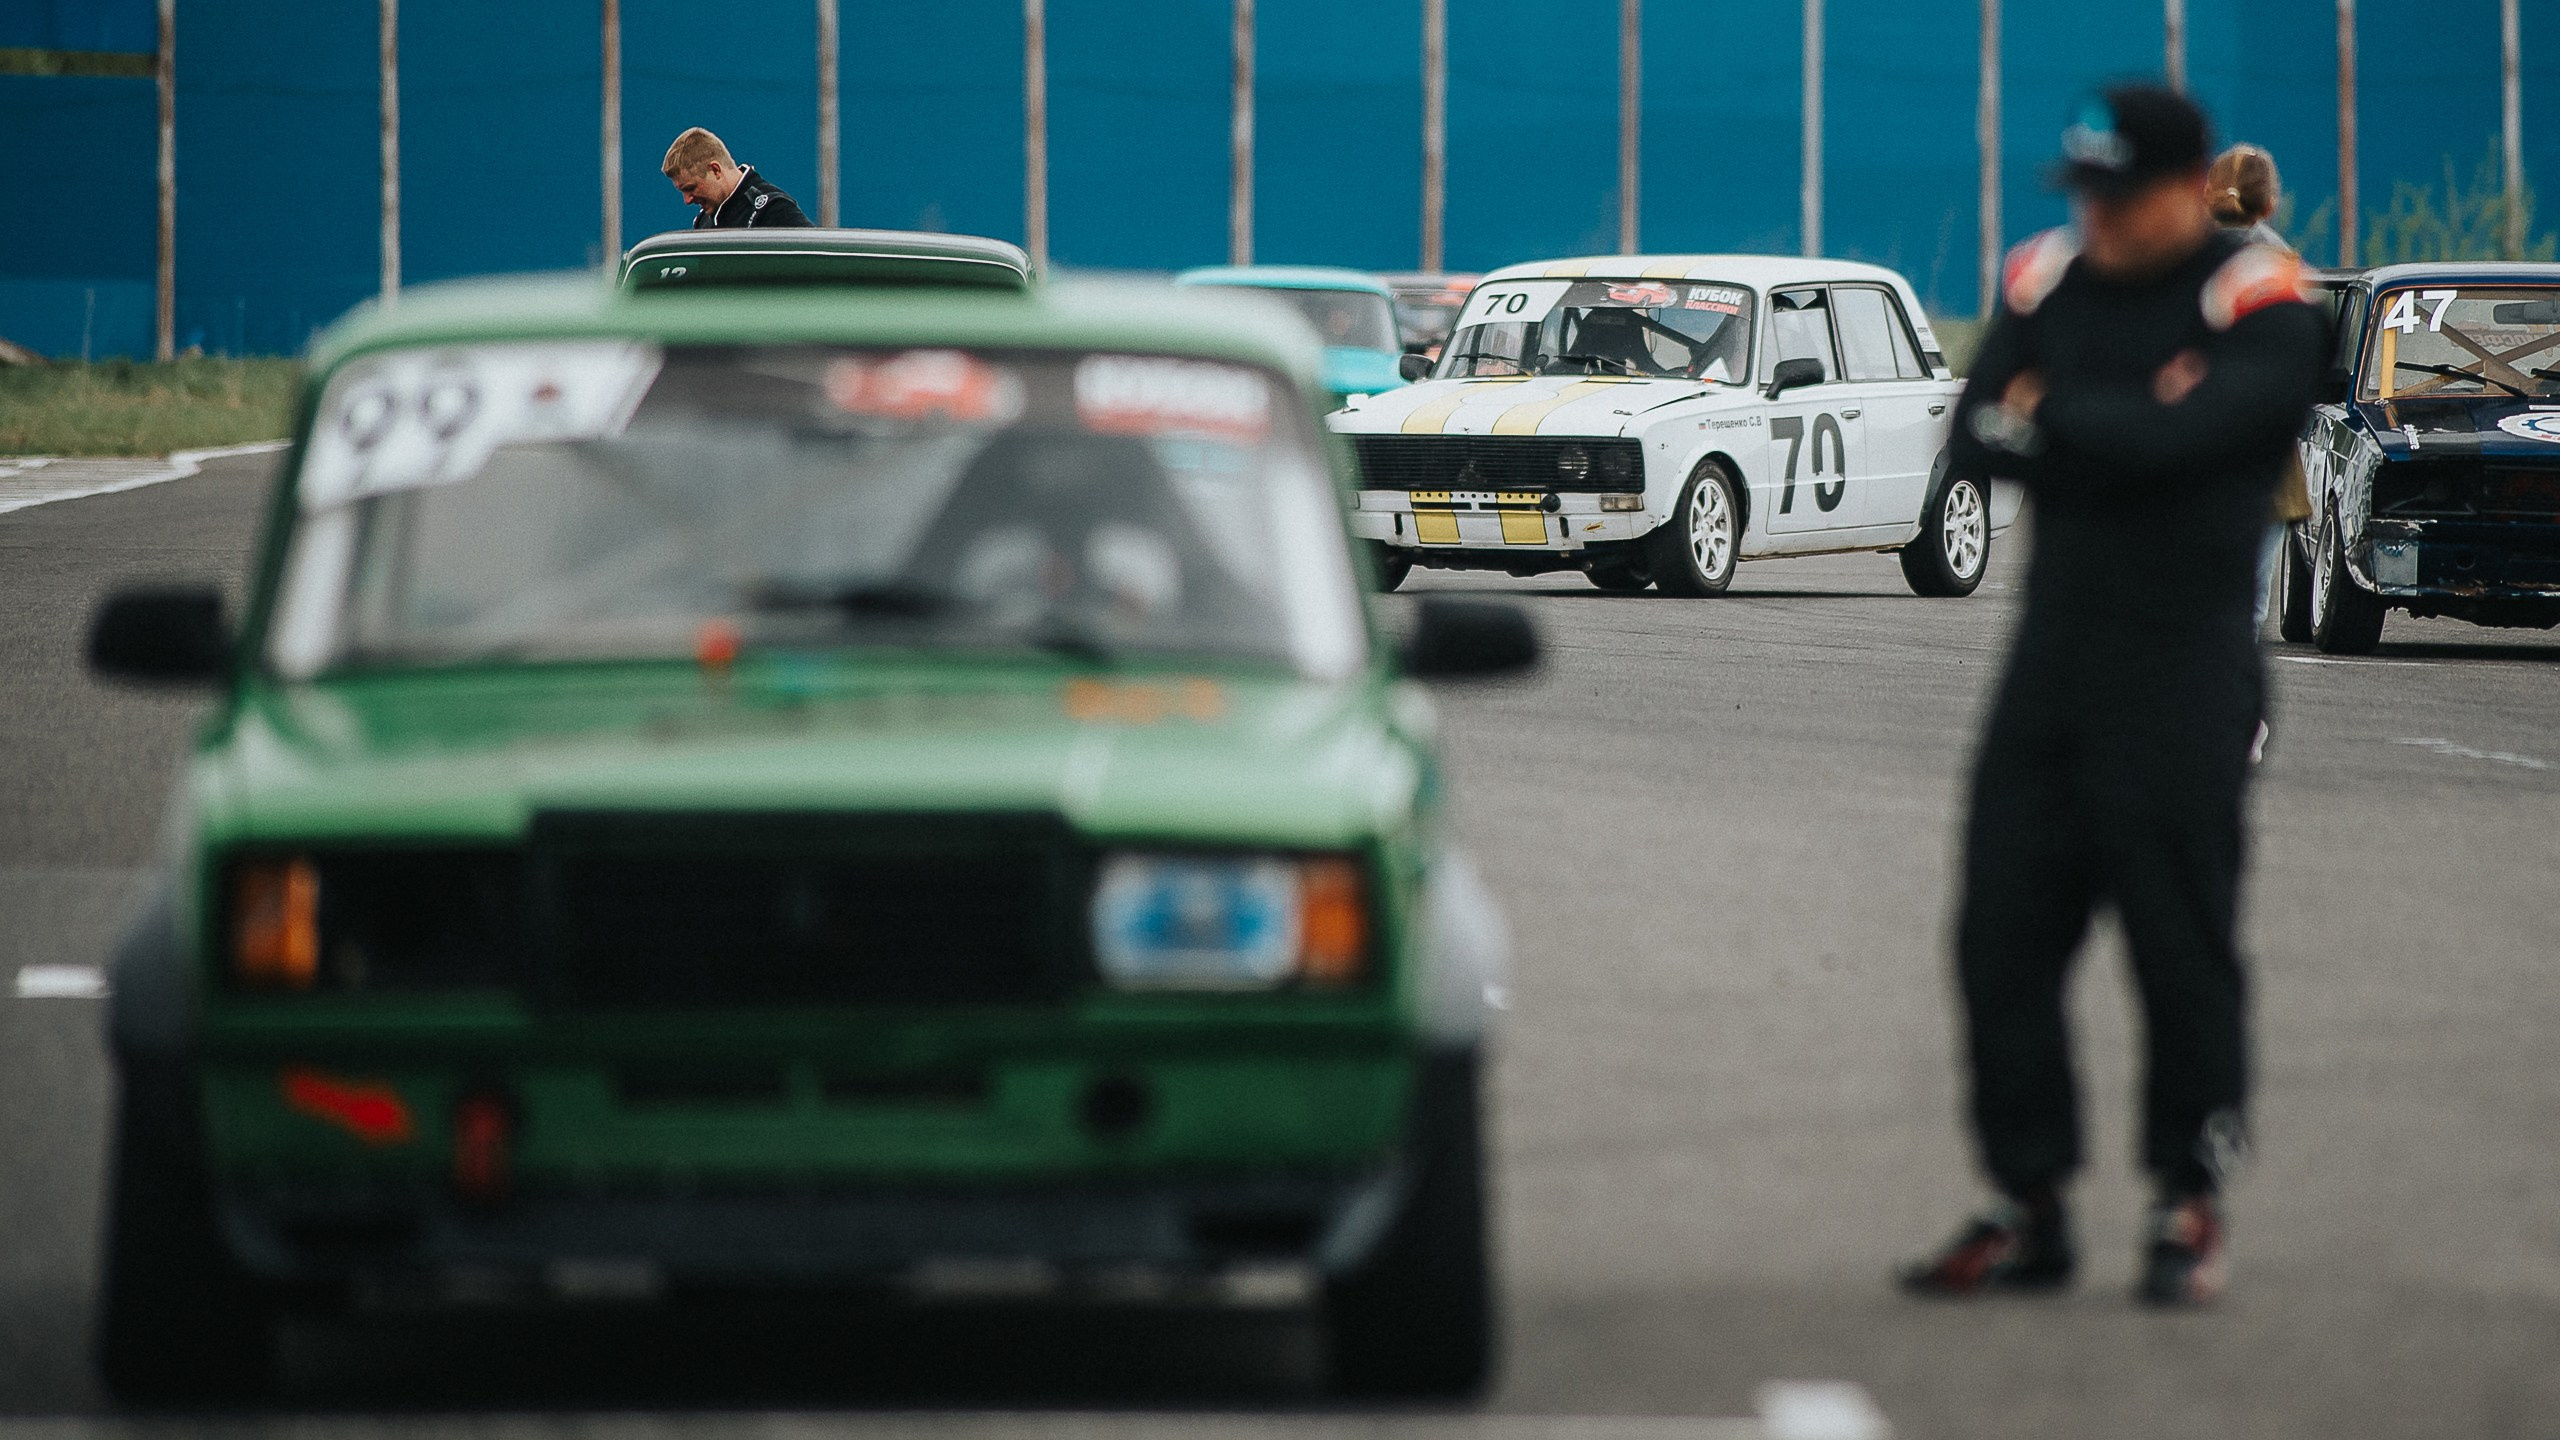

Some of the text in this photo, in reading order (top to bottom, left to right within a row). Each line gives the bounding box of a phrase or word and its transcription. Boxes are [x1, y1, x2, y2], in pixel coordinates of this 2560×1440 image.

[1484, 293, 1529, 316] 70
[1687, 286, 1744, 306] КУБОК
[1684, 300, 1740, 315] КЛАССИКИ
[2383, 289, 2458, 334] 47
[1705, 418, 1748, 431] Терещенко
[1769, 412, 1846, 515] 70
